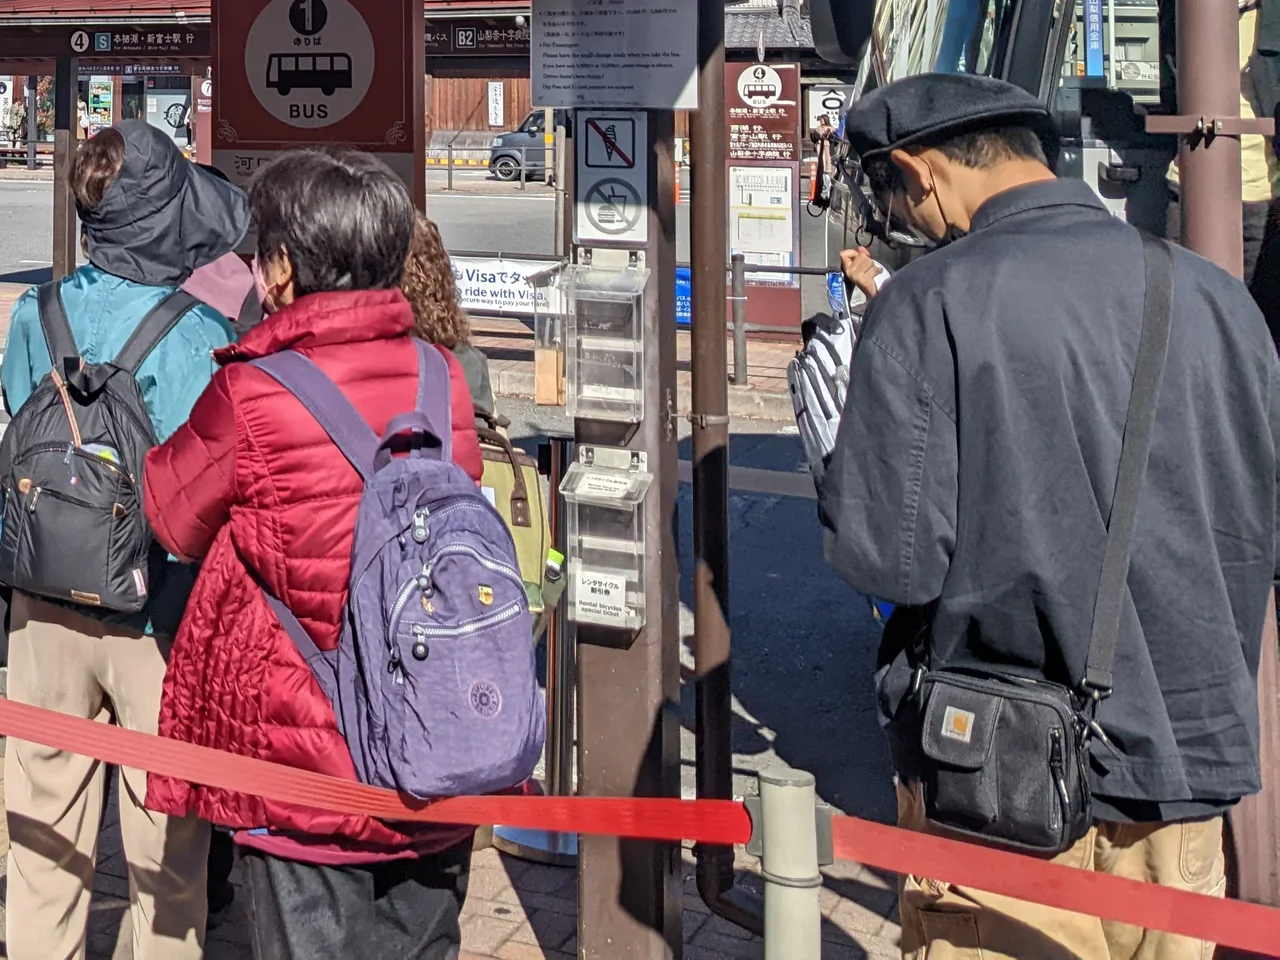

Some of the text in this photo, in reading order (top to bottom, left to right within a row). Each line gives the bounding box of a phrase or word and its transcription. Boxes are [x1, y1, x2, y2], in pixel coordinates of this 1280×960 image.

[99, 35, 107, 49] S
[293, 35, 323, 47] のりば
[458, 30, 473, 46] B2
[754, 67, 763, 79] 4
[289, 103, 328, 119] BUS
[465, 287, 547, 301] ride with Visa.
[502, 299, 514, 307] pay
[581, 578, 620, 590] レンタサイクル
[578, 600, 623, 612] Rental bicycles
[602, 609, 620, 617] ticket
